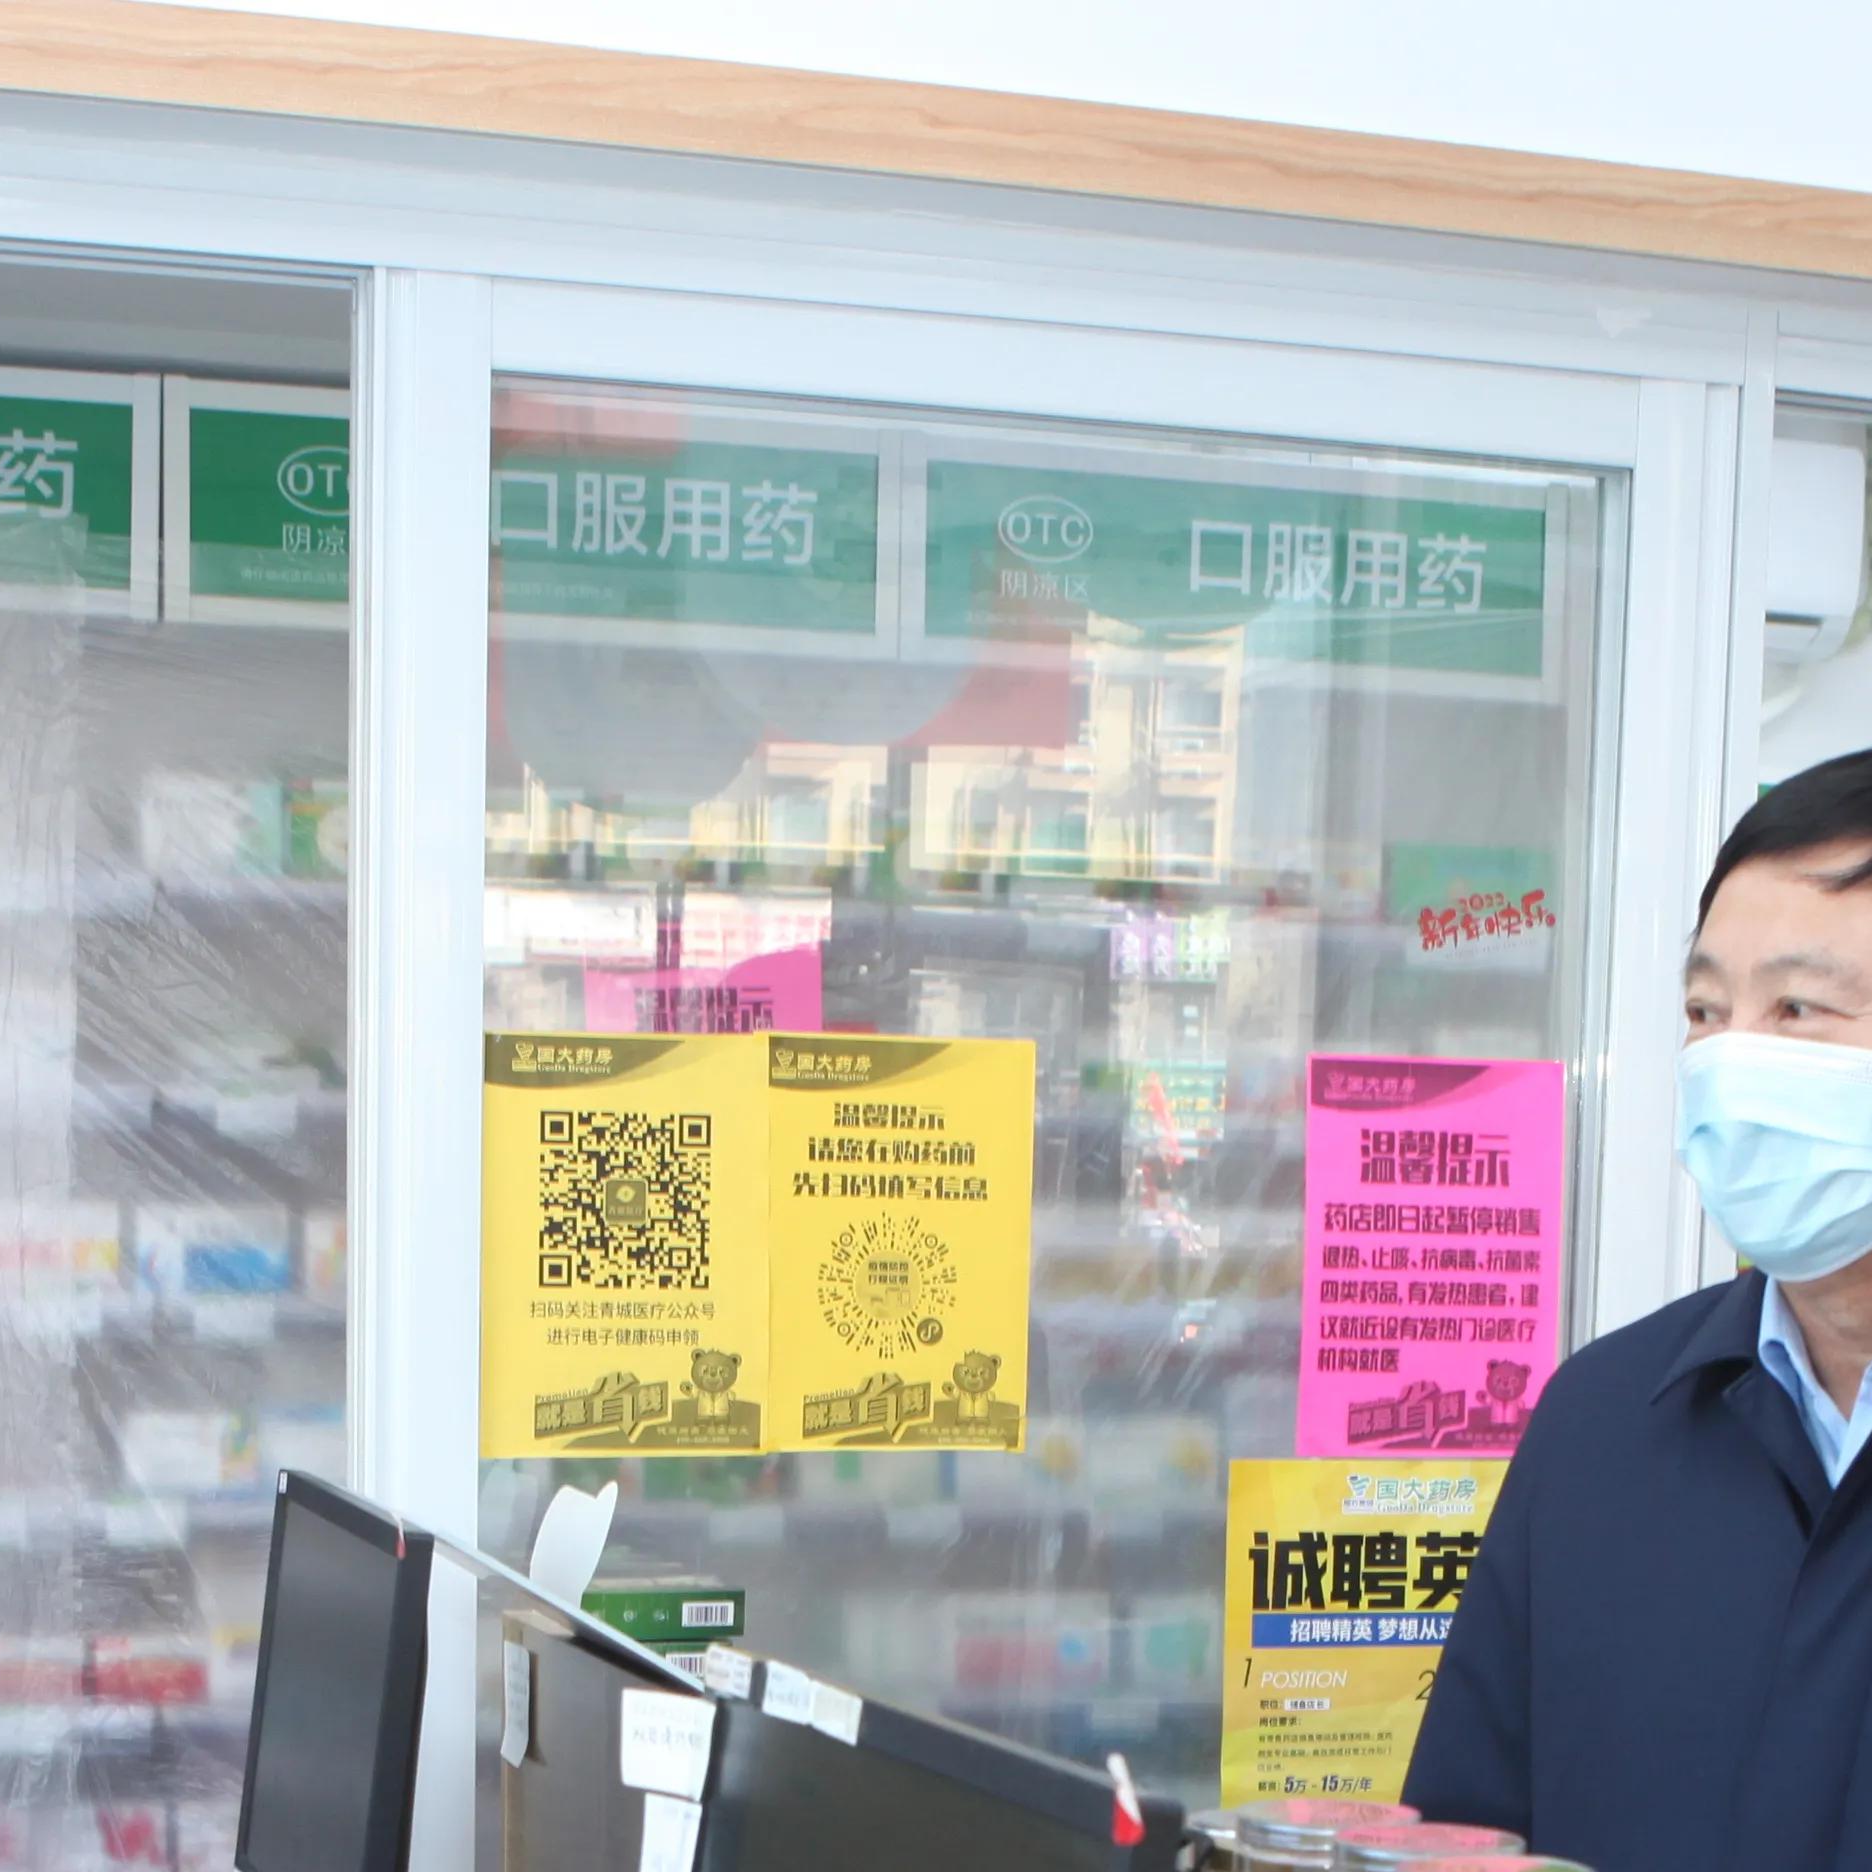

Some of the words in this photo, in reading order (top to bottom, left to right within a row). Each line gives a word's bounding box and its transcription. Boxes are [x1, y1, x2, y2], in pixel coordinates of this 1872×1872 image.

[286, 462, 349, 499] OT
[492, 470, 818, 566] 口服用药
[1005, 511, 1086, 547] OTC
[1189, 519, 1488, 612] 口服用药
[1000, 568, 1089, 600] 阴凉区
[536, 1046, 614, 1066] 国大药房
[797, 1052, 873, 1073] 国大药房
[833, 1102, 946, 1130] 温馨提示
[807, 1136, 976, 1166] 请您在购药前
[1360, 1128, 1511, 1188] 温馨提示
[792, 1171, 989, 1201] 先扫码填写信息
[1324, 1202, 1542, 1237] 药店即日起暂停销售
[529, 1300, 717, 1321] 扫码关注青城医疗公众号
[546, 1327, 701, 1347] 进行电子健康码申领
[1319, 1315, 1537, 1343] 议就近设有发热门诊医疗
[1317, 1347, 1401, 1373] 机构就医
[1376, 1478, 1478, 1501] 国大药房
[1248, 1531, 1486, 1611] 诚聘英
[1289, 1617, 1373, 1643] 招聘精英
[1243, 1657, 1253, 1689] 1
[1260, 1669, 1348, 1690] POSITION
